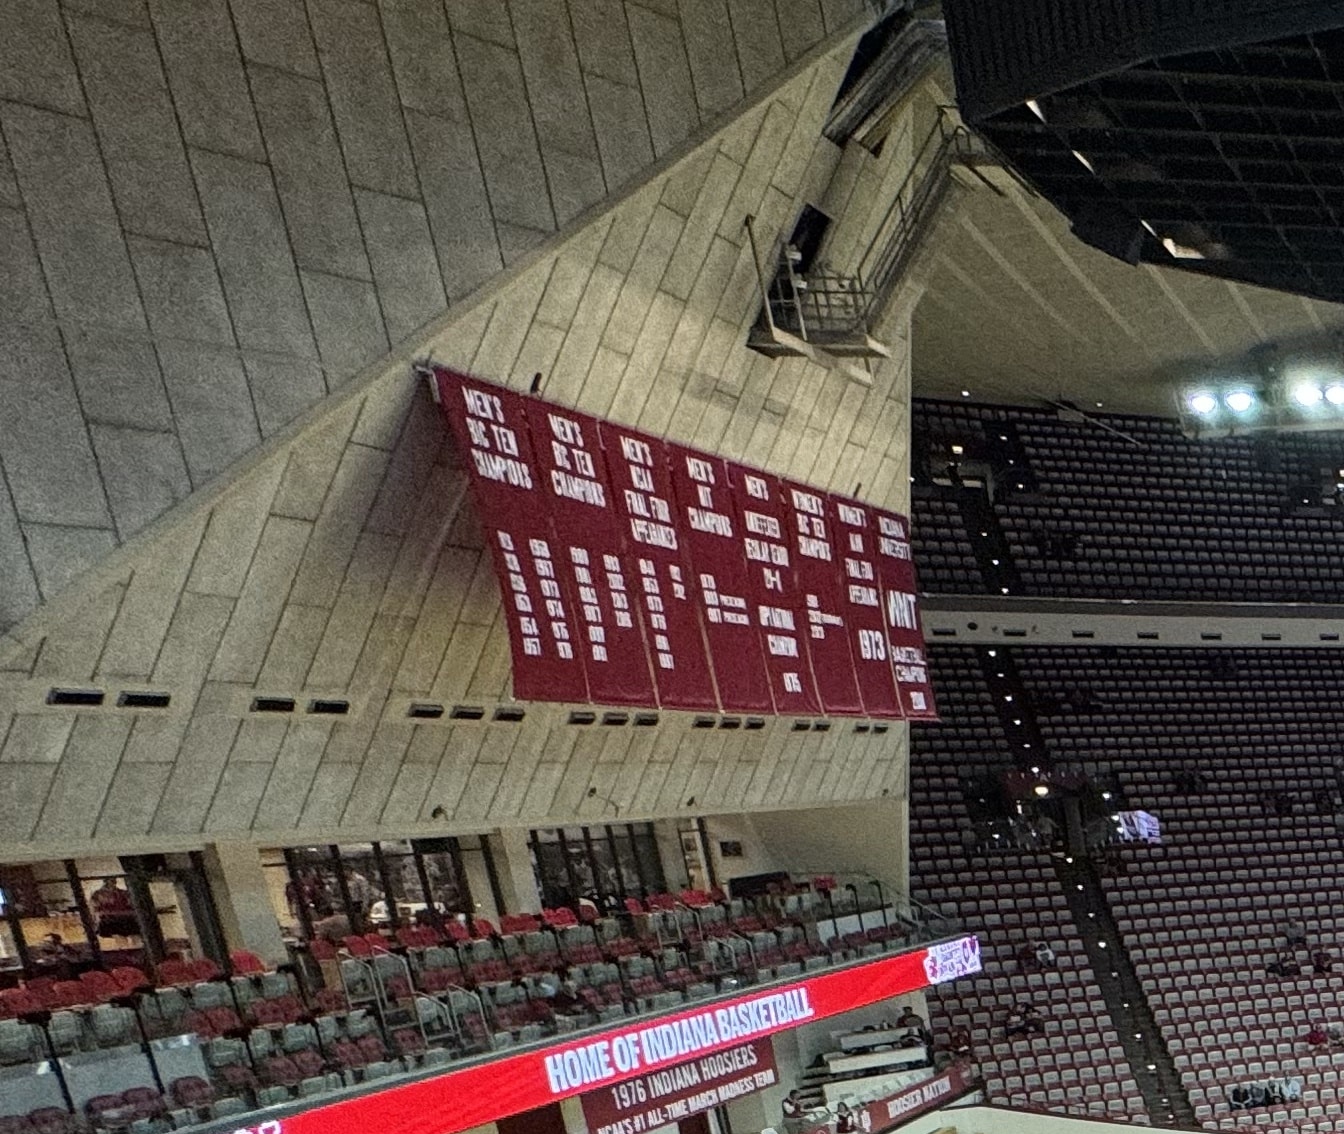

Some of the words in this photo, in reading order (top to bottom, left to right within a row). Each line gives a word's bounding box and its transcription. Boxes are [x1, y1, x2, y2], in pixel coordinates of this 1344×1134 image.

[544, 1042, 615, 1094] HOME
[612, 1034, 640, 1074] OF
[640, 1013, 720, 1064] INDIANA
[714, 987, 814, 1043] BASKETBALL
[610, 1079, 647, 1111] 1976
[649, 1064, 701, 1099] INDIANA
[700, 1044, 758, 1085] HOOSIERS
[647, 1099, 689, 1129] ALL-TIME
[688, 1089, 719, 1115] MARCH
[719, 1077, 755, 1107] MADNESS
[754, 1068, 776, 1093] TEAM
